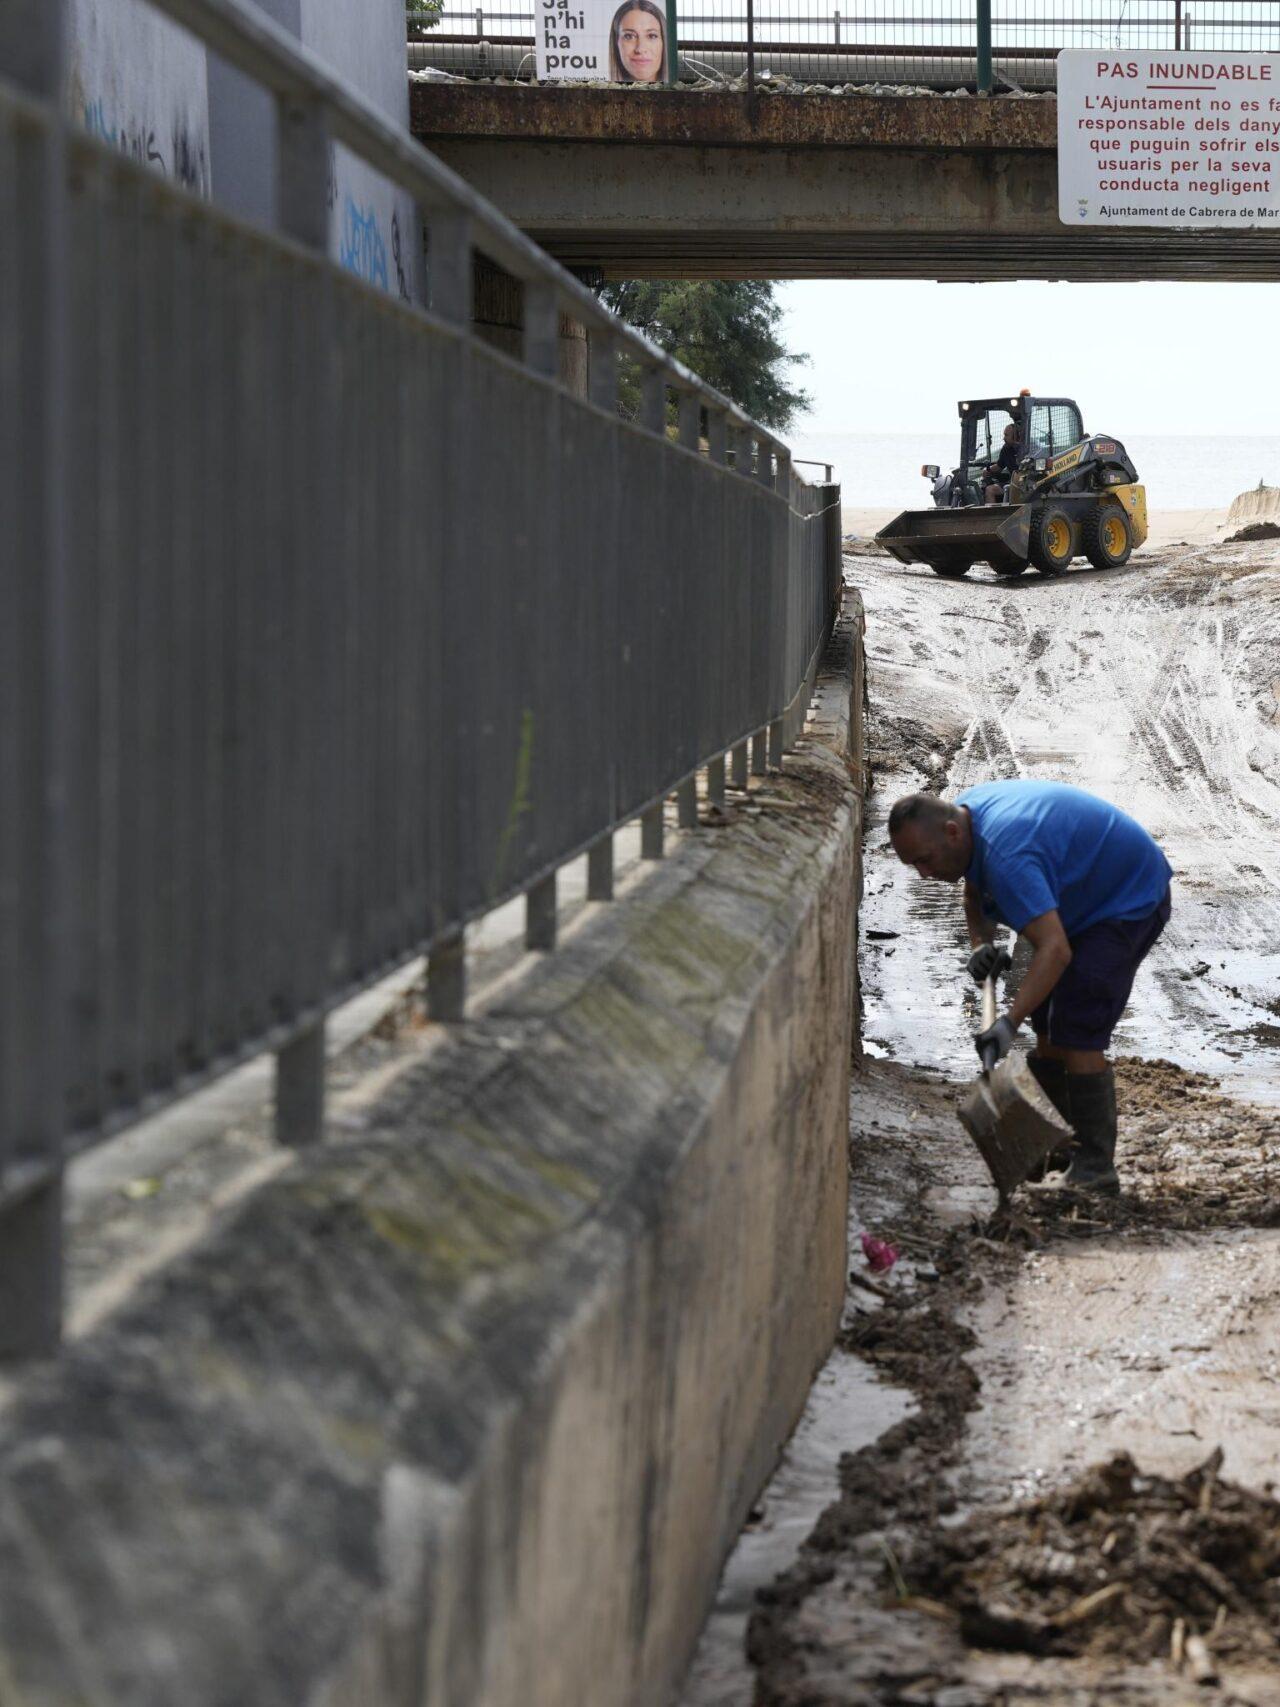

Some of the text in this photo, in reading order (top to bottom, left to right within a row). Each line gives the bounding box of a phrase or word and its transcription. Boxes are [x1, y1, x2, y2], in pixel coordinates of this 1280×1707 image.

[545, 30, 571, 49] ha
[546, 54, 597, 73] prou
[1097, 62, 1272, 80] PAS INUNDABLE
[1085, 96, 1201, 112] L'Ajuntament
[1211, 100, 1231, 111] no
[1241, 101, 1259, 111] es
[1078, 118, 1185, 132] responsable
[1195, 118, 1230, 131] dels
[1090, 138, 1279, 153] que puguin sofrir els
[1098, 158, 1271, 173] usuaris per la seva
[1100, 178, 1270, 194] conducta negligent
[1100, 206, 1279, 217] Ajuntament de Cabrera de Mar
[1054, 453, 1077, 471] HOLLAND
